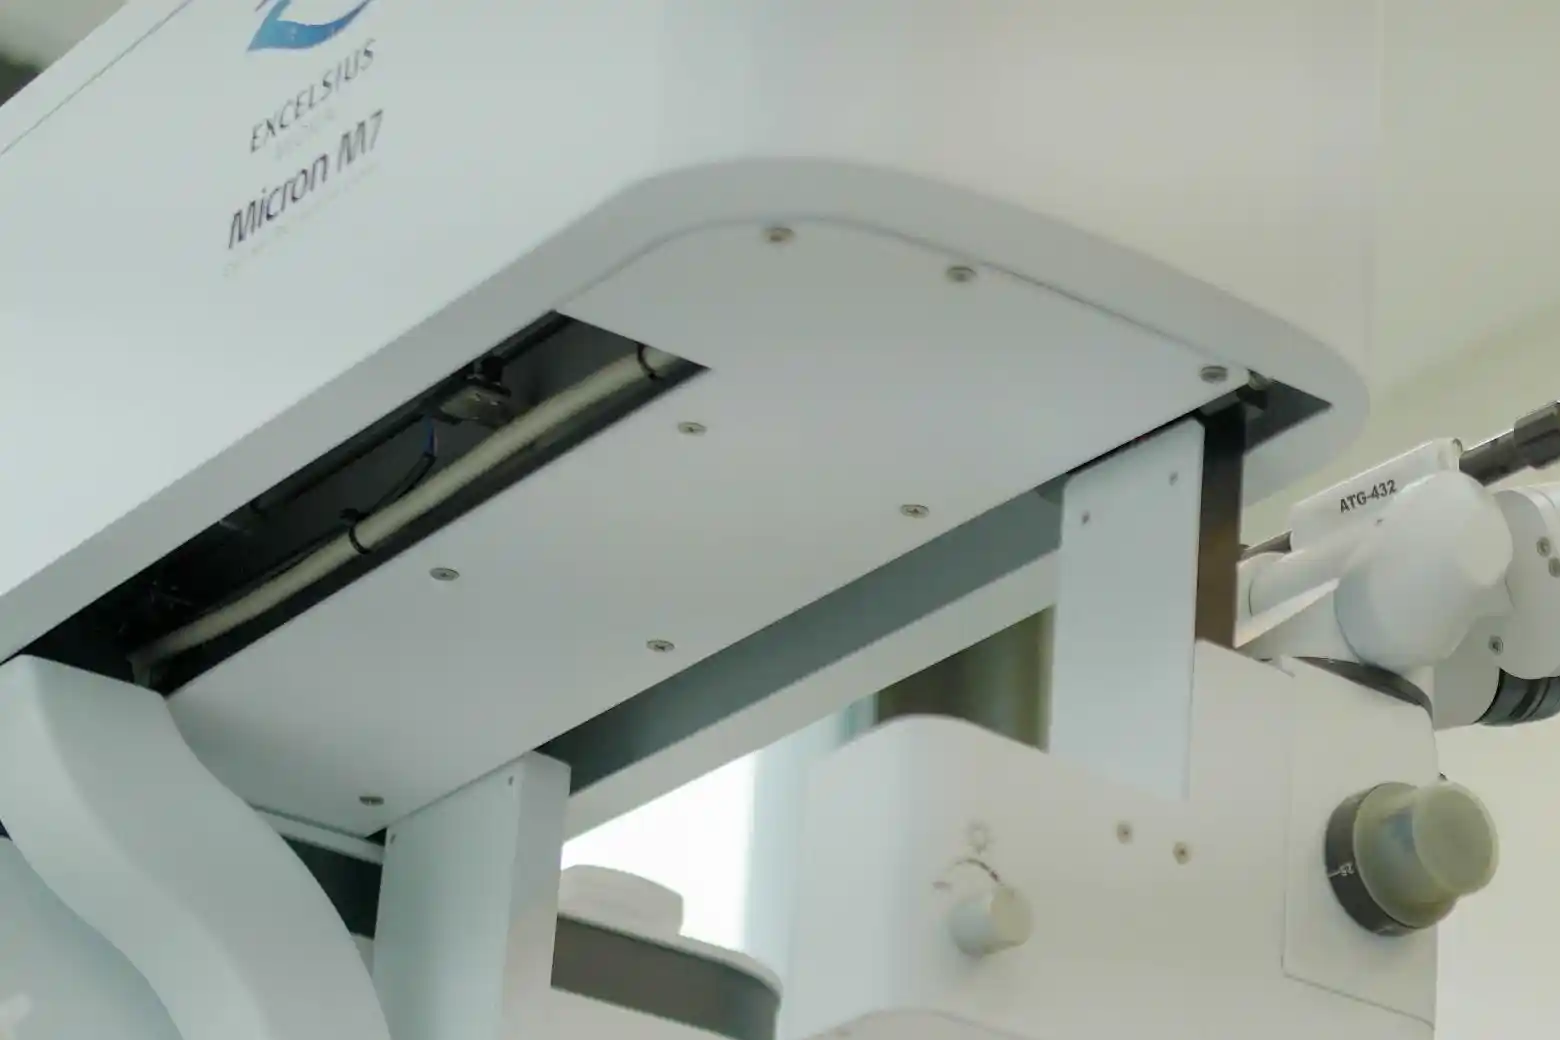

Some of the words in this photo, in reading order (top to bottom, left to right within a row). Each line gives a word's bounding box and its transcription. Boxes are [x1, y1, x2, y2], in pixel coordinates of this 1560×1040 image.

[250, 37, 377, 153] EXCELSIUS
[228, 153, 329, 250] Micron
[337, 108, 384, 173] M7
[1339, 479, 1398, 514] ATG-432
